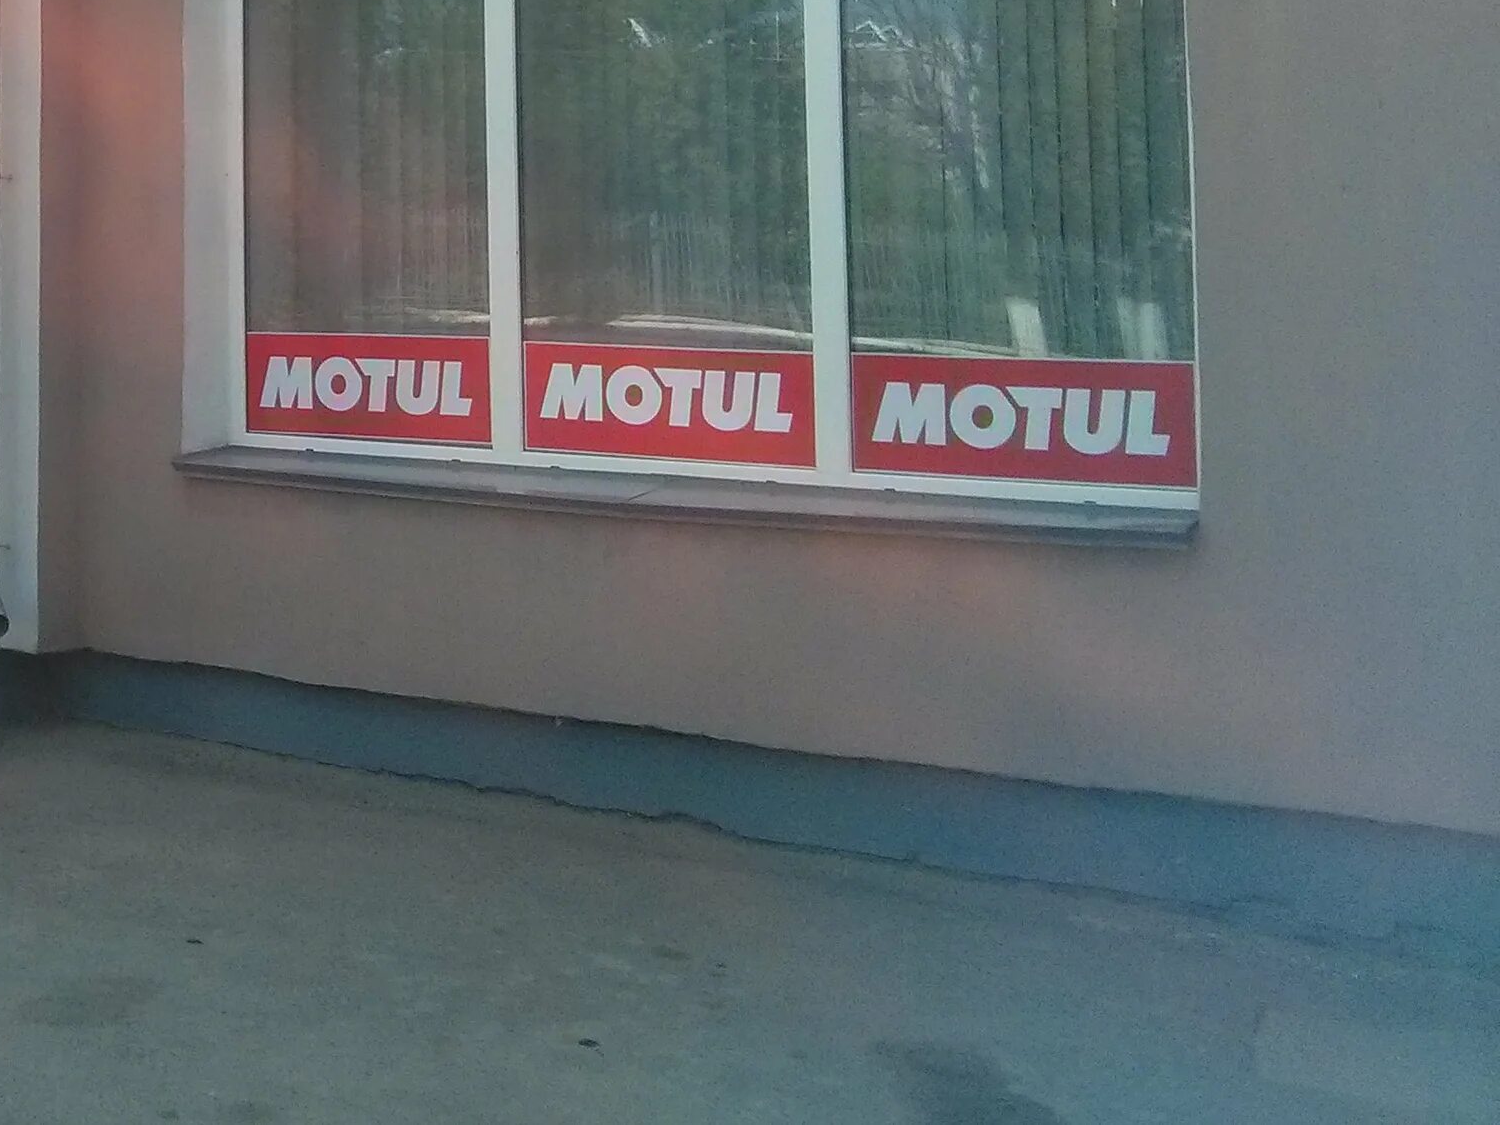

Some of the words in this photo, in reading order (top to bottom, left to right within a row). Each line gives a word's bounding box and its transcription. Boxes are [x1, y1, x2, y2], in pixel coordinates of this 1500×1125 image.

[258, 355, 473, 419] MOTUL
[539, 363, 794, 434] MOTUL
[871, 381, 1171, 458] MOTUL
